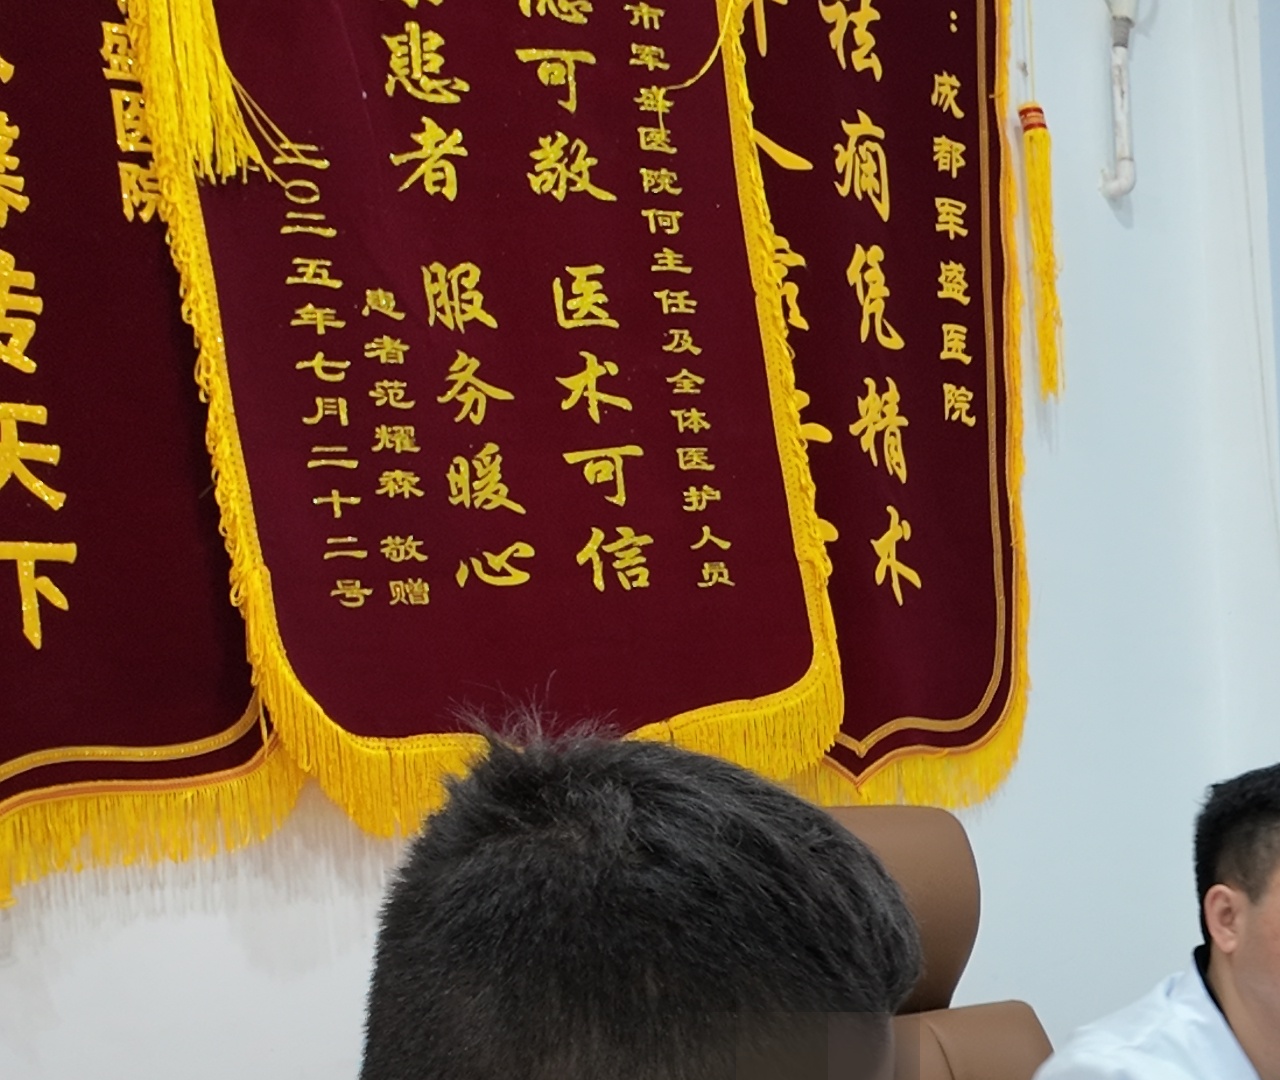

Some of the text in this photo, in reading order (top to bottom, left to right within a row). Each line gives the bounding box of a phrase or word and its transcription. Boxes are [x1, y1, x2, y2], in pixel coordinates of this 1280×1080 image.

[382, 0, 536, 588] 患者 服务暖心
[552, 264, 655, 592] 医术可信
[380, 536, 430, 605] 敬赠
